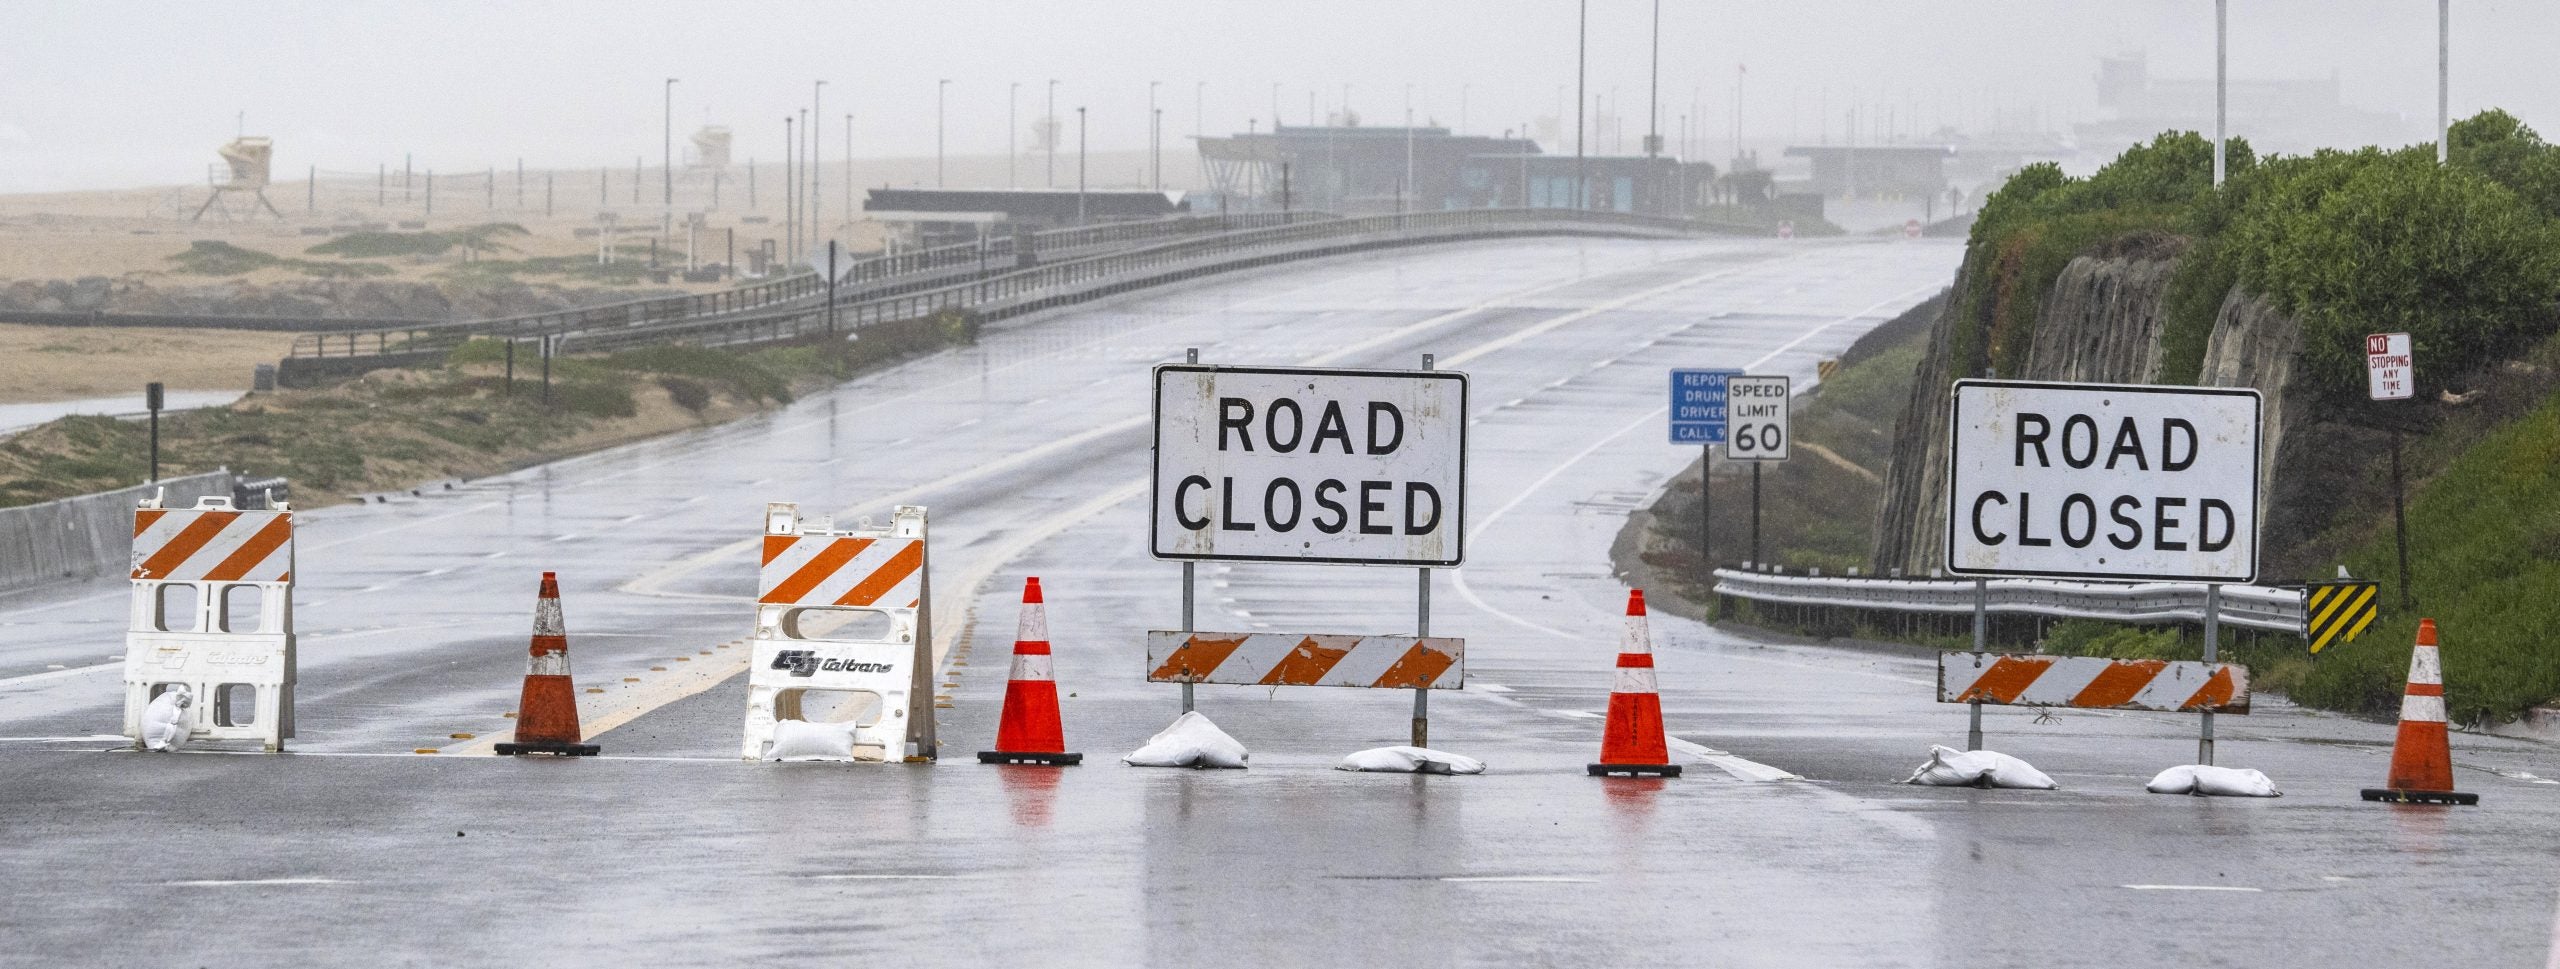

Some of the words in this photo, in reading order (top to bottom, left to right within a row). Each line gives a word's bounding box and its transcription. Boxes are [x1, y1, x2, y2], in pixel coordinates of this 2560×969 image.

[2370, 337, 2385, 353] NO
[2371, 355, 2409, 369] STOPPING
[1684, 374, 1725, 386] REPOR
[2382, 369, 2399, 379] ANY
[1732, 385, 1784, 397] SPEED
[2382, 381, 2401, 390] TIME
[1680, 406, 1726, 418] DRIVER
[1737, 405, 1778, 417] LIMIT
[1218, 397, 1404, 455] ROAD
[1679, 427, 1711, 439] CALL
[1735, 423, 1781, 451] 60
[2014, 412, 2198, 472] ROAD
[1174, 475, 1442, 536] CLOSED
[1971, 490, 2235, 552] CLOSED
[821, 658, 894, 673] Caltrans
